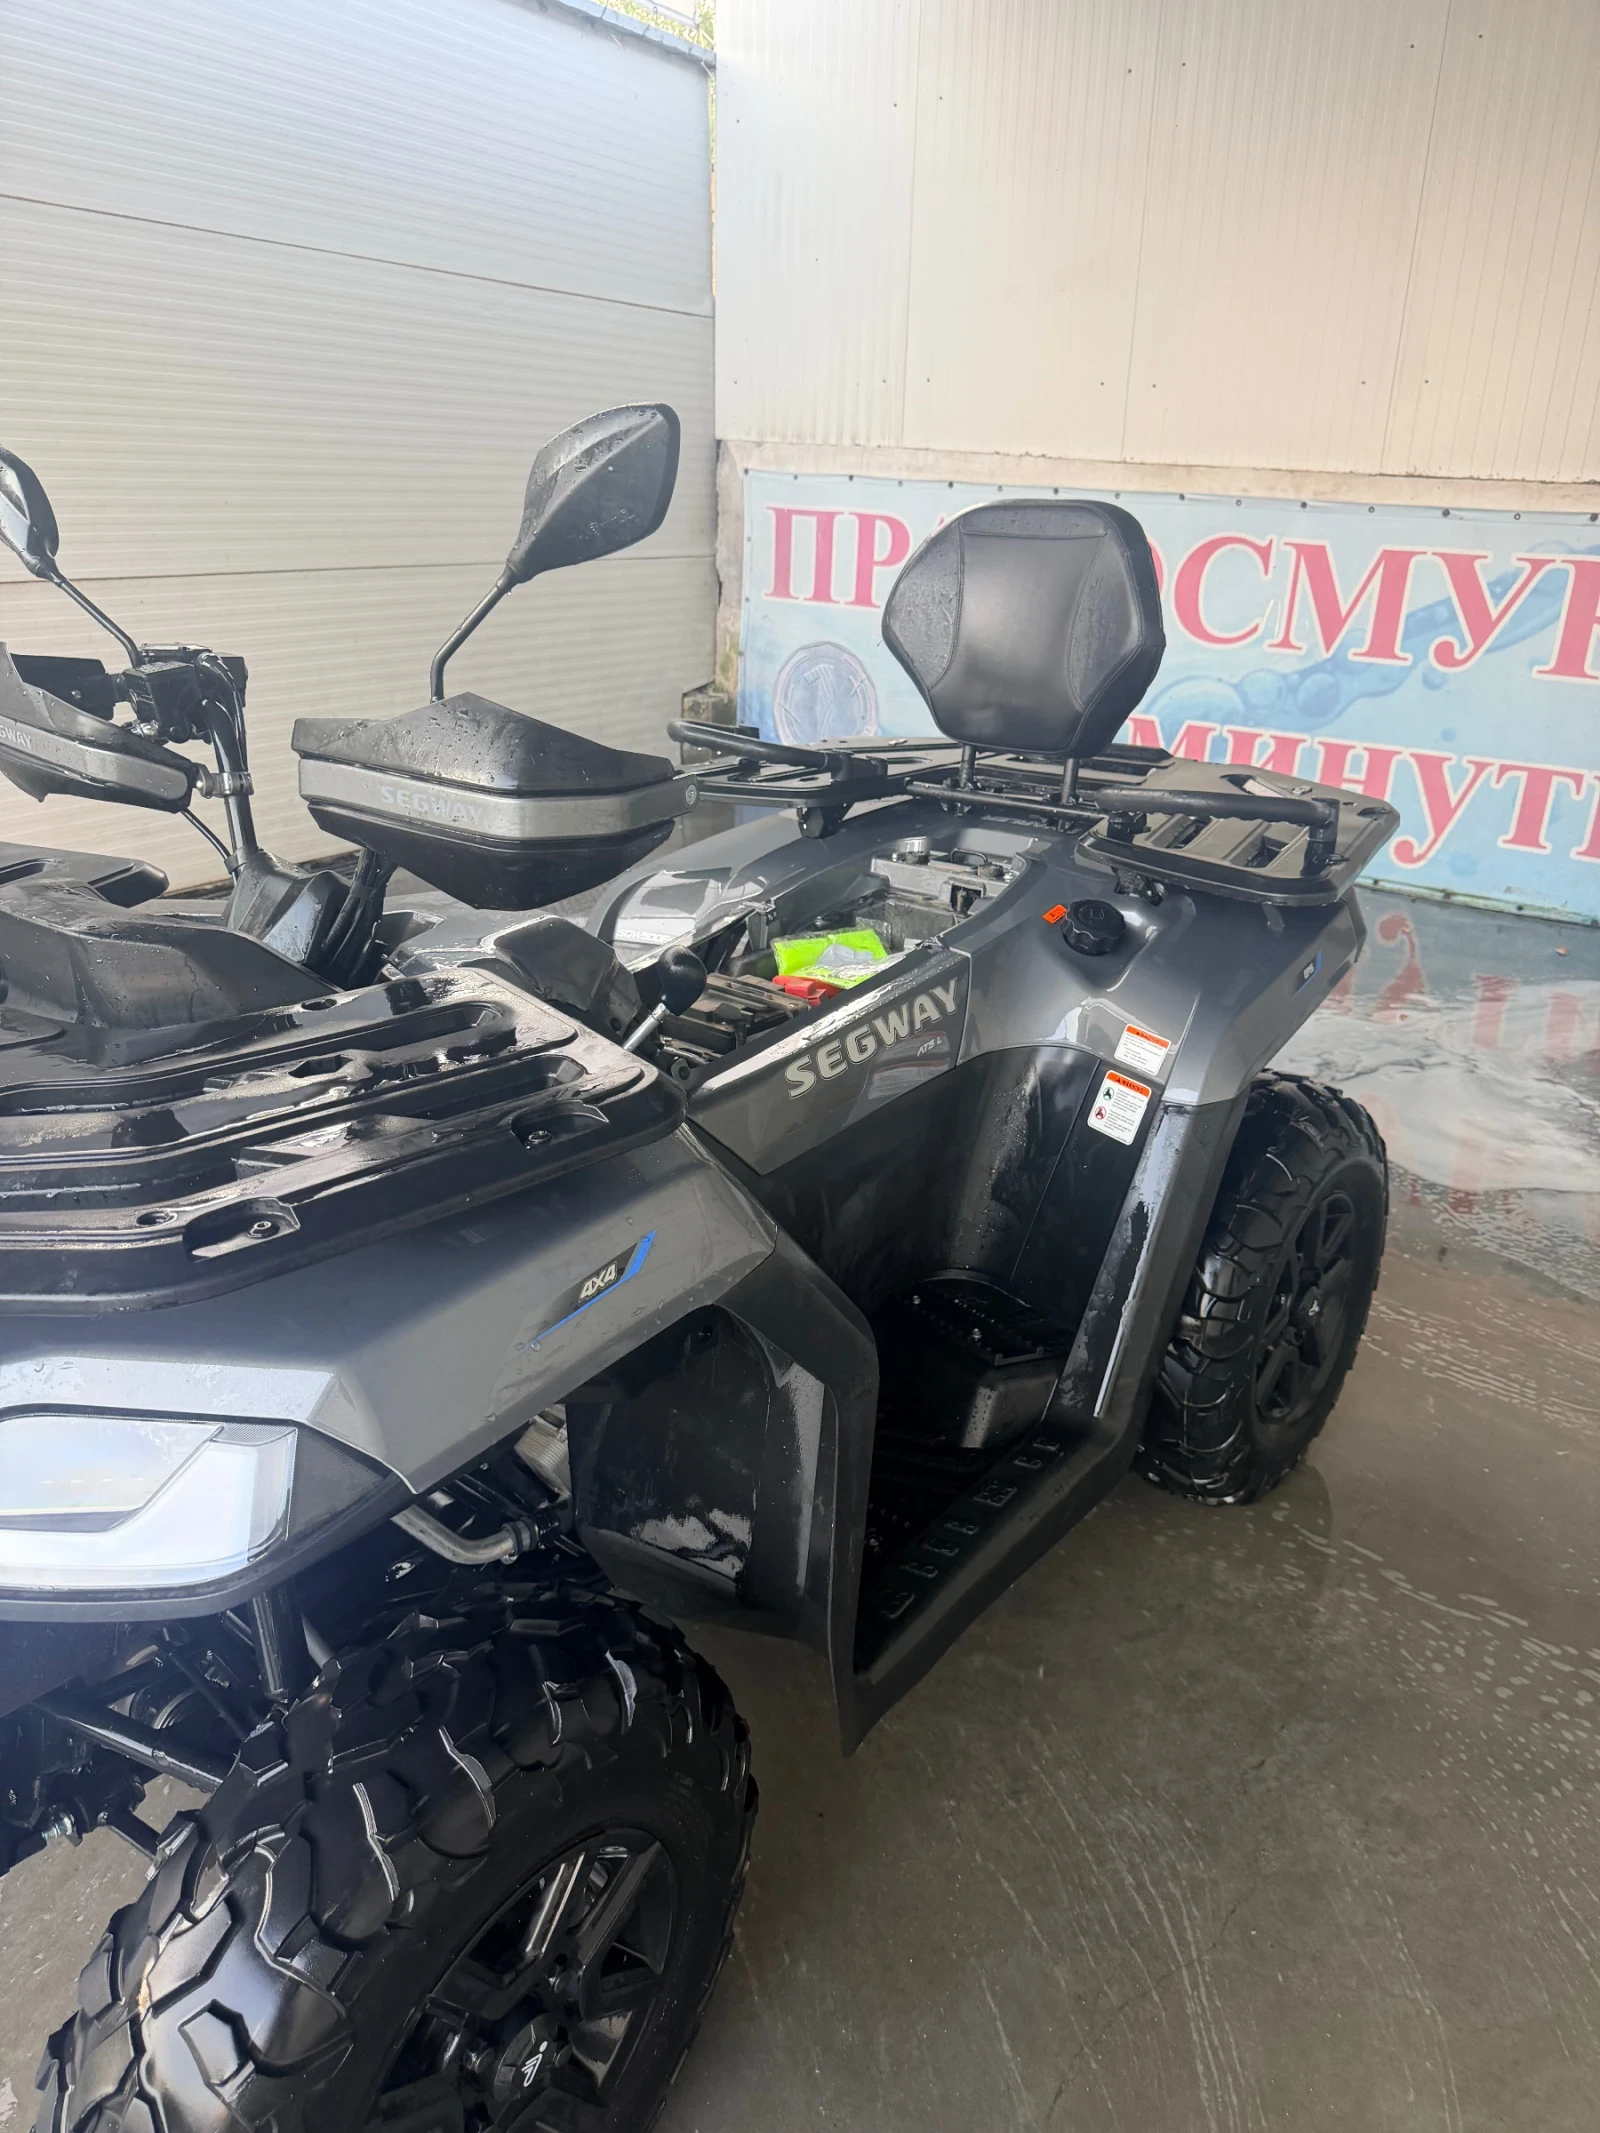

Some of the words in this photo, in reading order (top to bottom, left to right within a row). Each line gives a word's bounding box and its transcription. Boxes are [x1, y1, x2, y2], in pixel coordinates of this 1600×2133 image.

[381, 785, 483, 826] SEGWAY
[1124, 716, 1600, 866] МИНУТ
[785, 977, 957, 1099] SEGWAY
